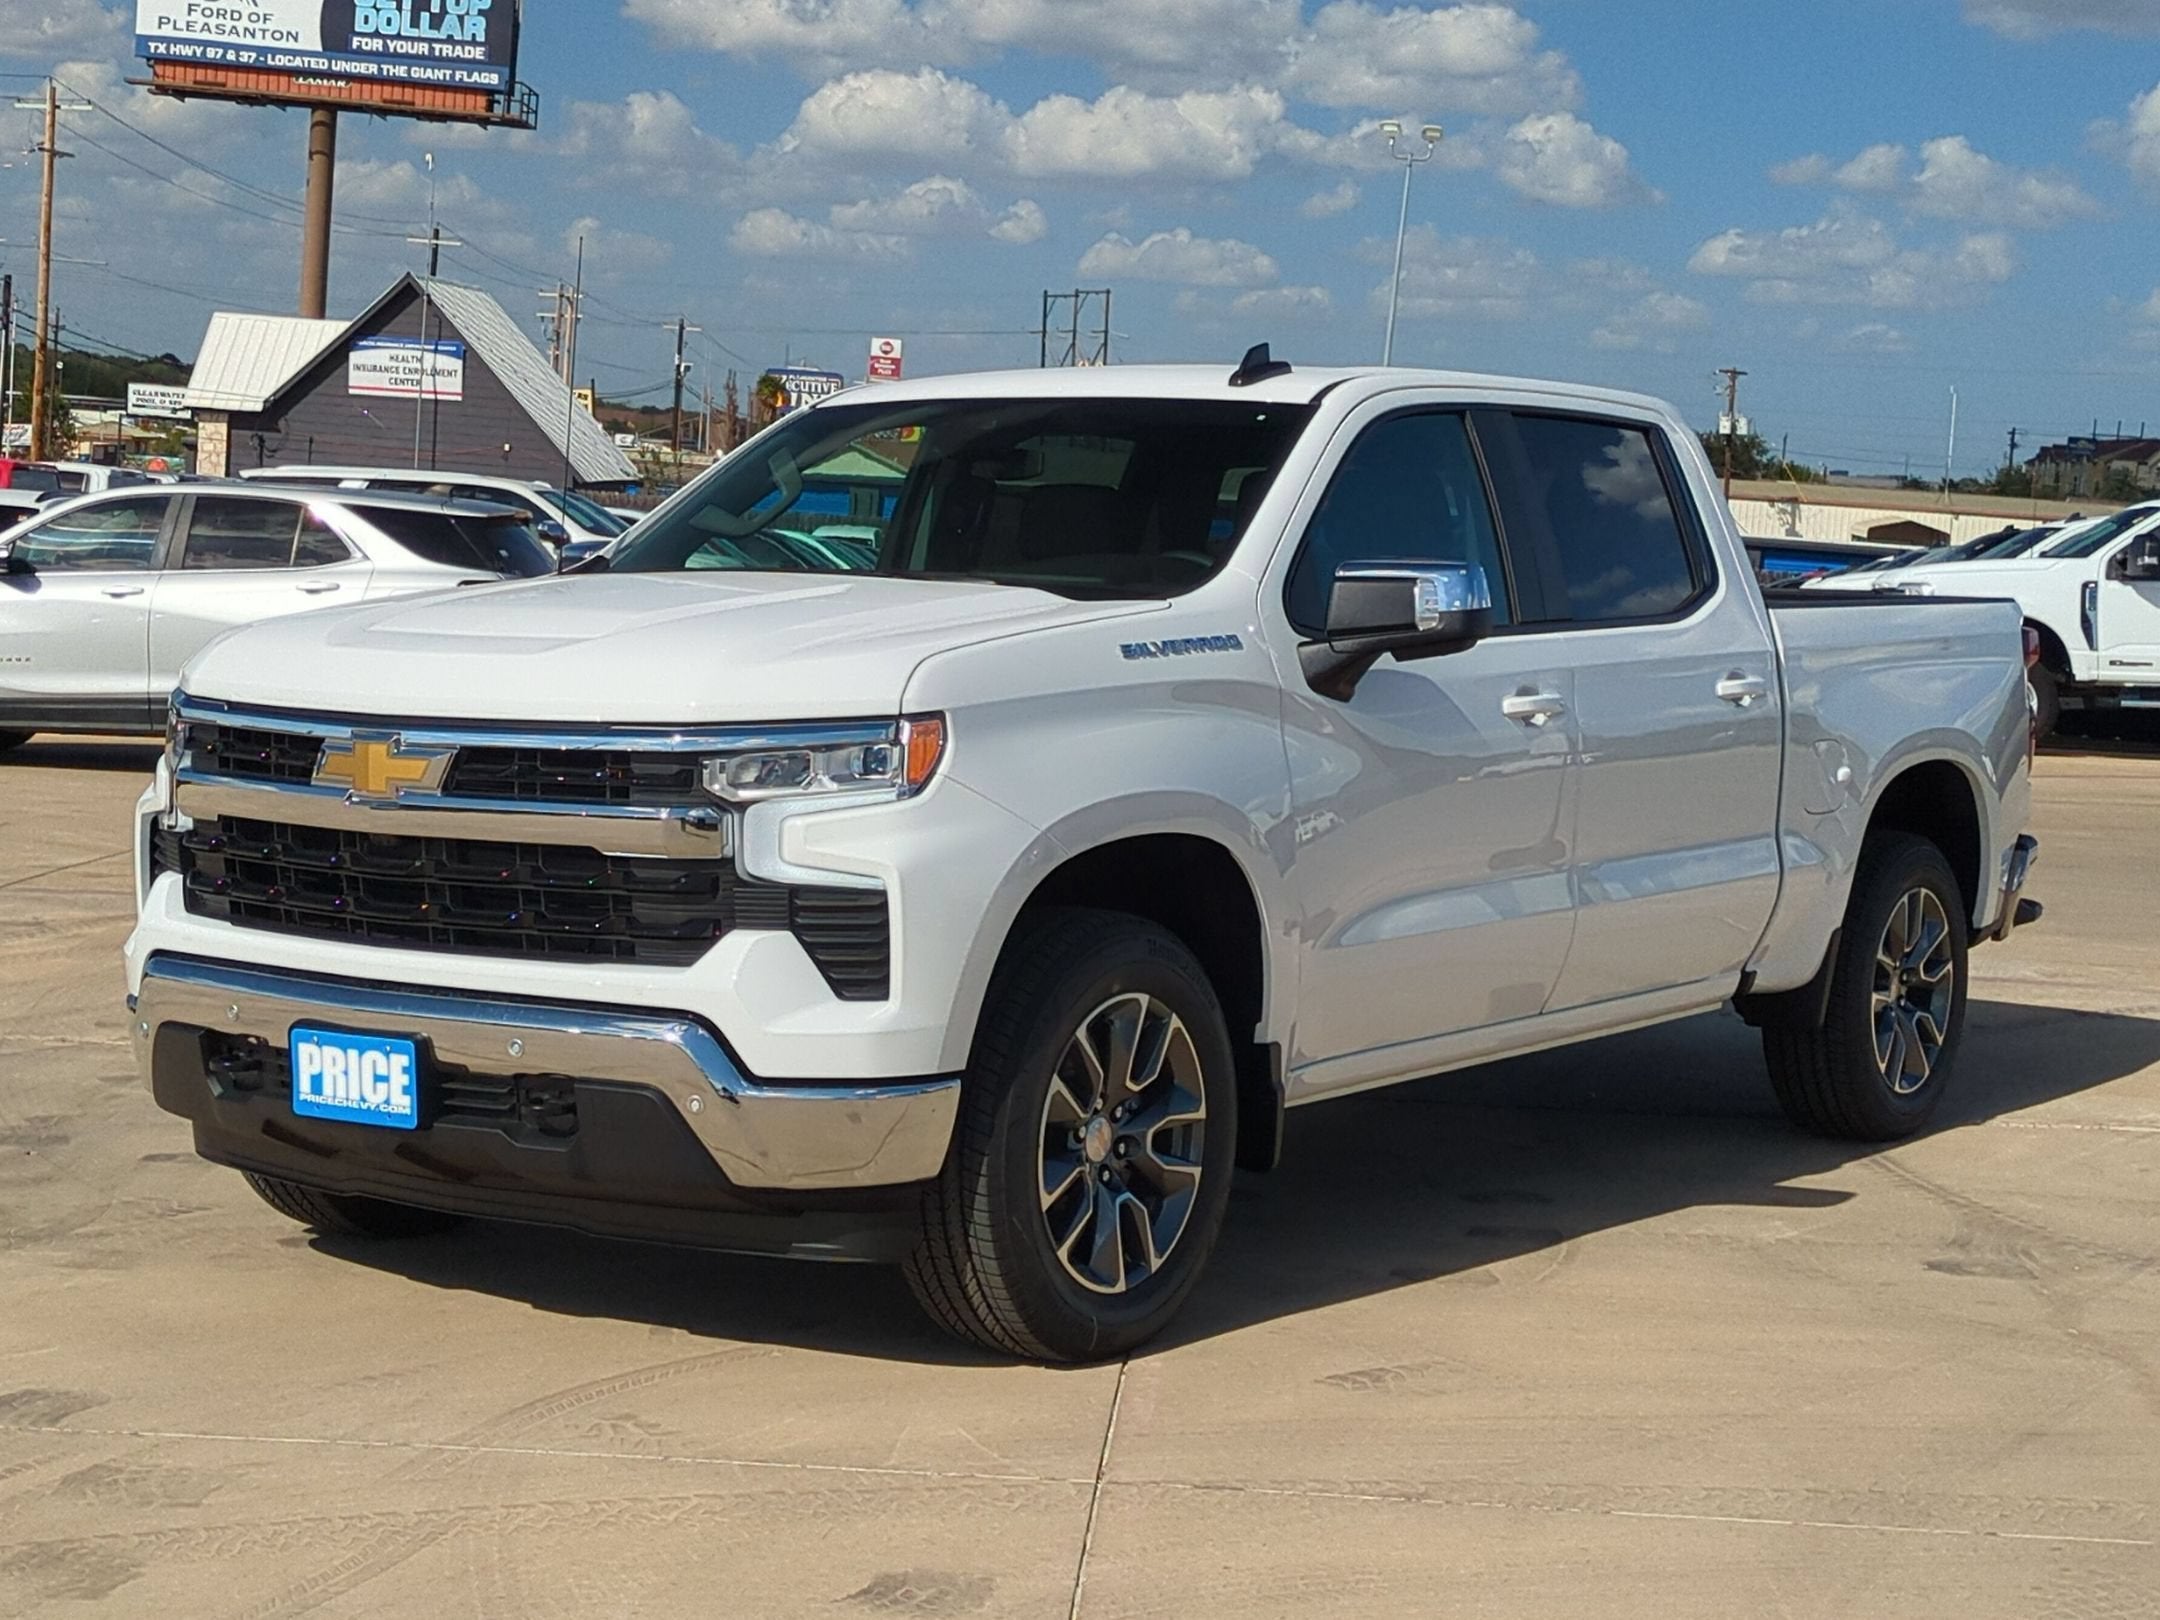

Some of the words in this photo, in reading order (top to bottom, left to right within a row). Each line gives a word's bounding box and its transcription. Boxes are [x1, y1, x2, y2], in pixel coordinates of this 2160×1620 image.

[187, 3, 242, 22] FORD
[247, 12, 274, 24] OF
[354, 7, 487, 42] DOLLAR
[158, 16, 299, 43] PLEASANTON
[352, 37, 383, 51] FOR
[386, 40, 429, 56] YOUR
[432, 44, 486, 60] TRADE
[148, 42, 167, 54] TX
[170, 44, 204, 58] HWY
[206, 47, 225, 59] 97
[226, 49, 237, 61] &
[239, 51, 257, 63] 37
[267, 54, 329, 70] LOCATED
[332, 60, 378, 75] UNDER
[381, 65, 408, 78] THE
[411, 68, 453, 82] GIANT
[455, 71, 499, 85] FLAGS
[353, 363, 400, 375] INSURANCE
[389, 354, 421, 364] HEALTH
[1120, 634, 1244, 660] SILVERADO
[297, 1042, 411, 1106] PRICE
[298, 1093, 411, 1116] PRICECHEVY.COM
